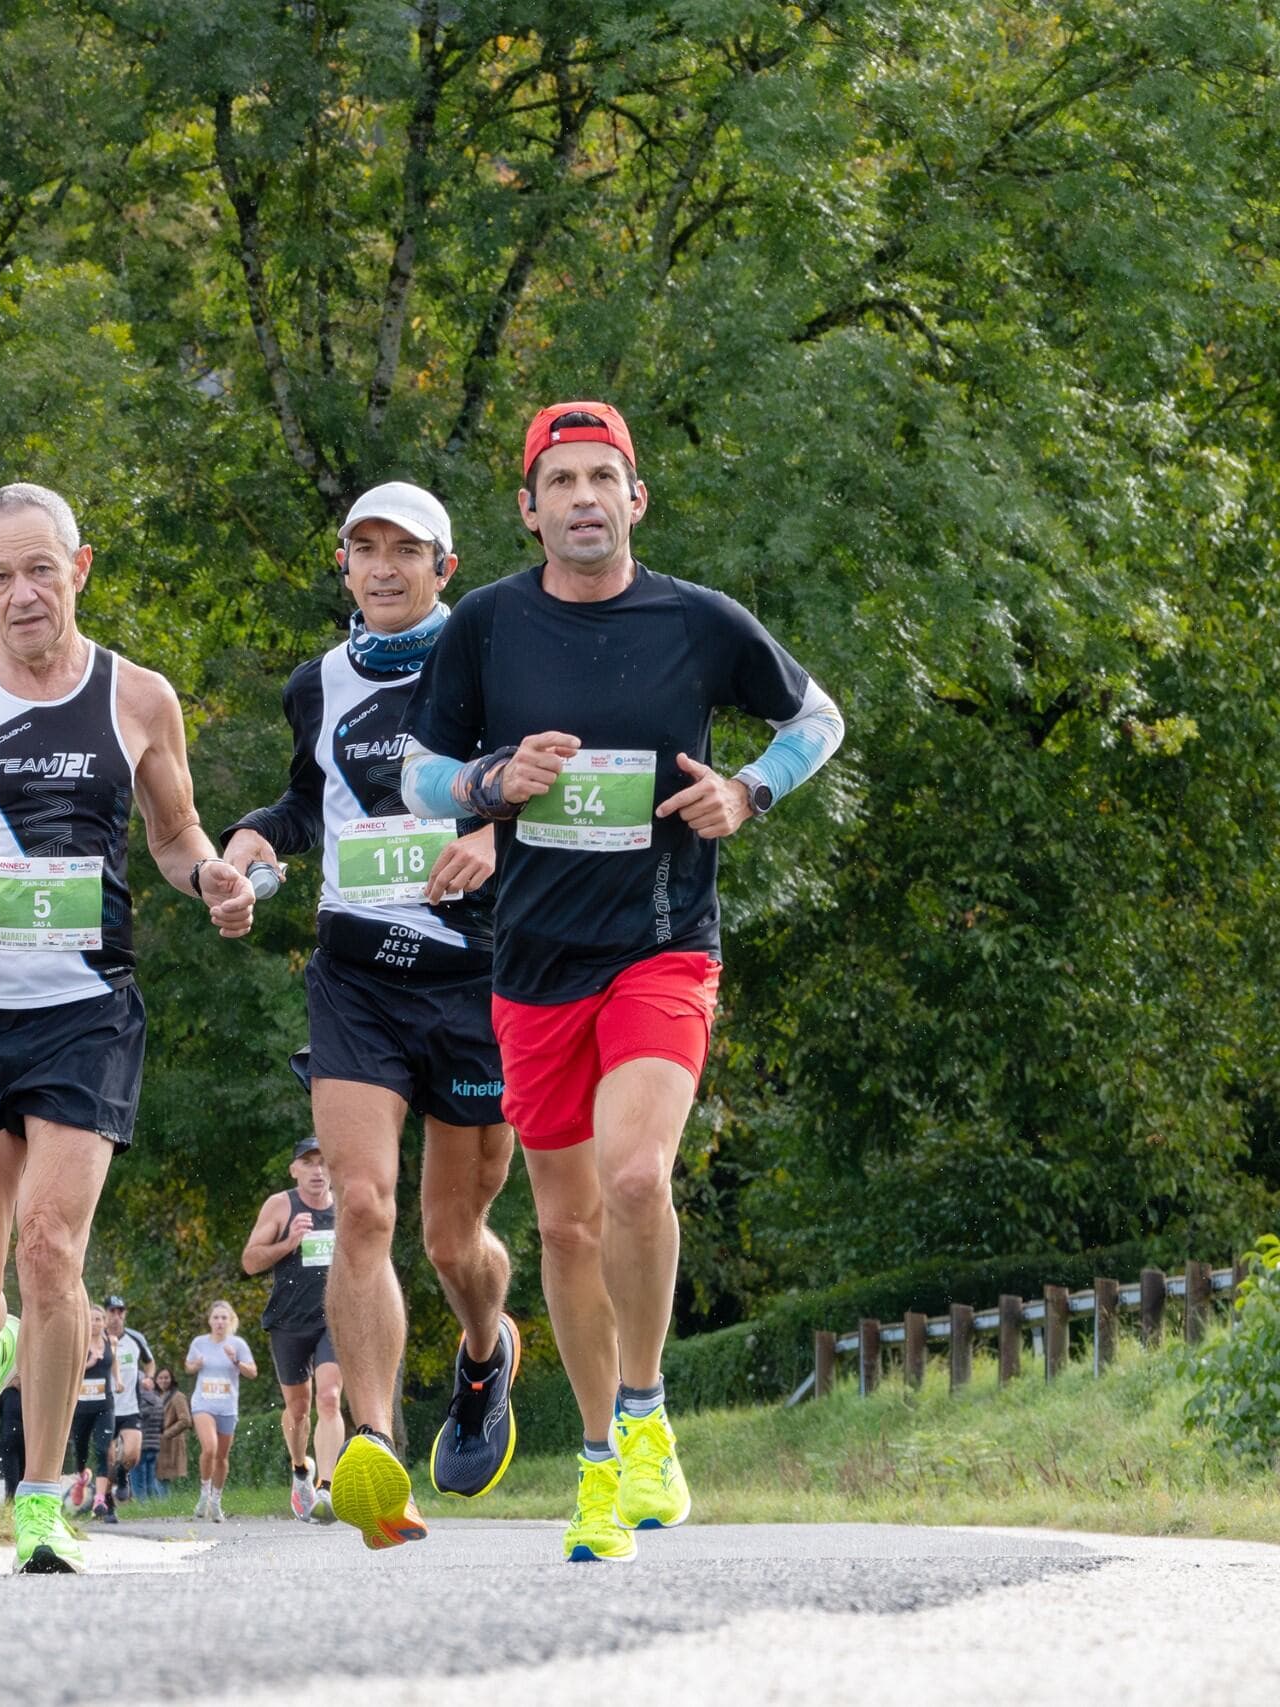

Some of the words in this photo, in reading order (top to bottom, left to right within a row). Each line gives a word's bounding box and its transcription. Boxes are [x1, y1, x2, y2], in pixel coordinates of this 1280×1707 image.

[563, 785, 605, 816] 54
[354, 822, 386, 830] ANNECY
[373, 845, 425, 875] 118
[33, 890, 51, 919] 5
[382, 939, 421, 954] RESS
[374, 951, 416, 968] PORT
[451, 1078, 507, 1097] kinetik
